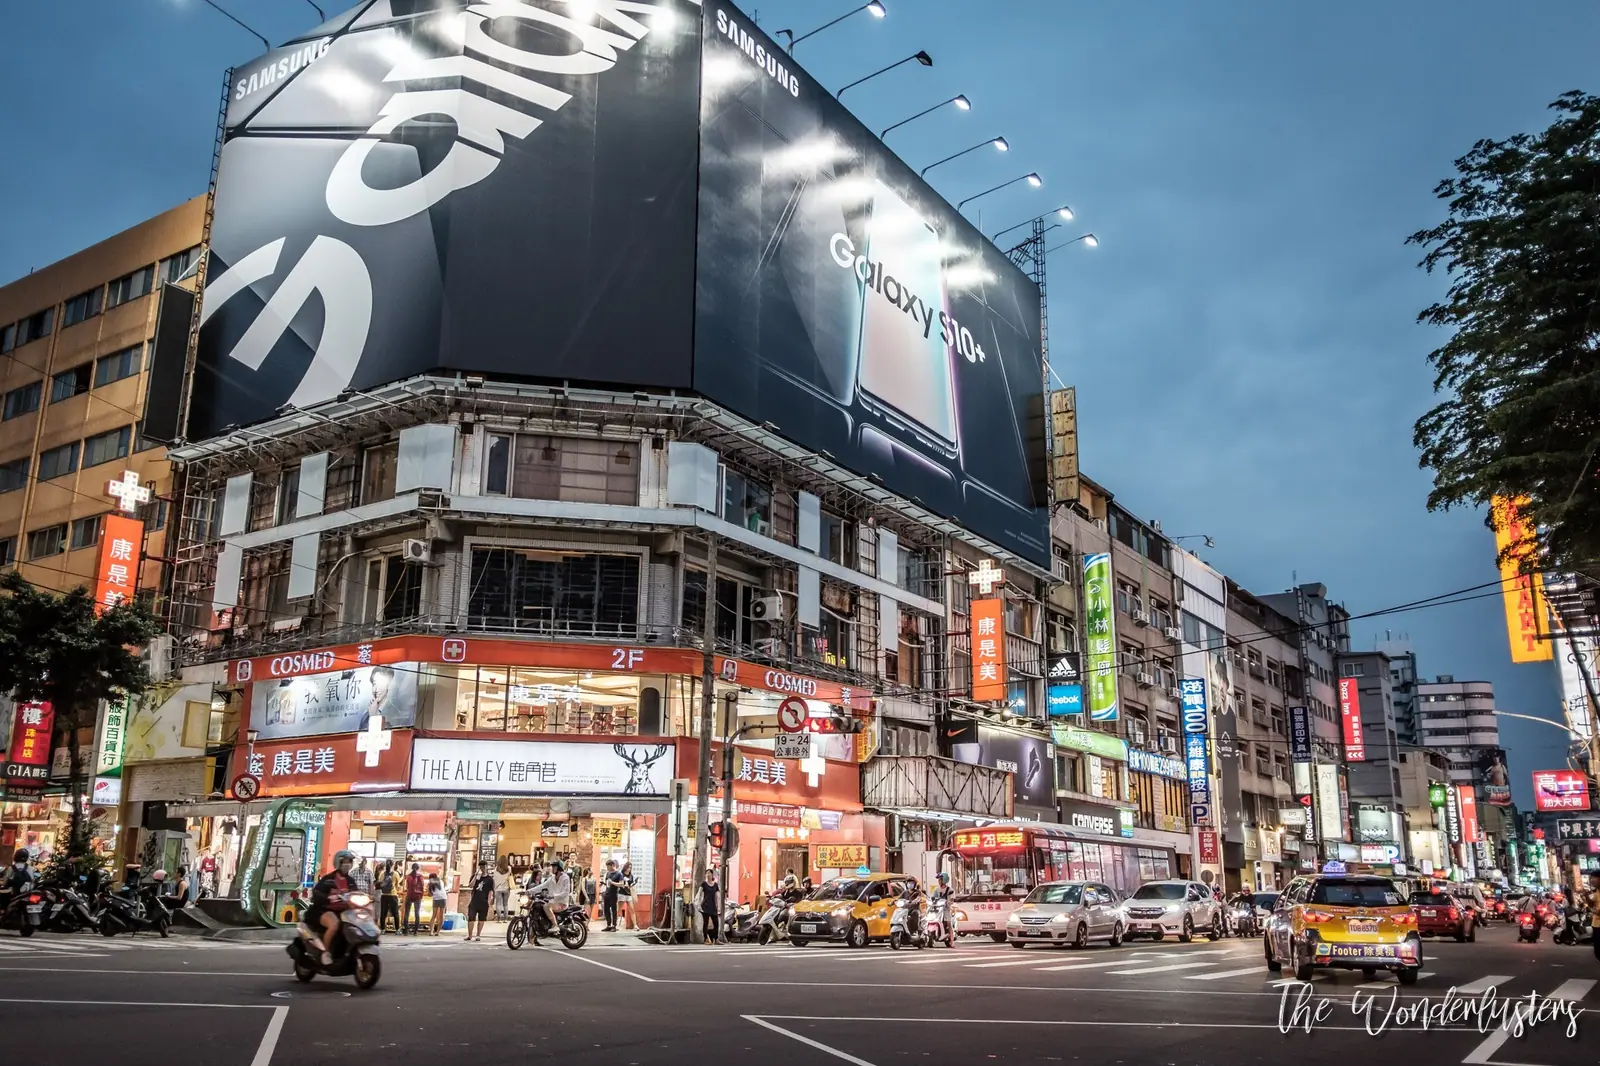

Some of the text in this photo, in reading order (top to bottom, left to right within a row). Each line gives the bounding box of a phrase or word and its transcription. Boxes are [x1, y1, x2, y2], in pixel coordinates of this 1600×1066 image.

[716, 8, 799, 98] SAMSUNG
[235, 36, 332, 101] SAMSUNG
[829, 231, 986, 363] Galaxy S10+
[611, 648, 644, 669] 2F
[977, 616, 998, 681] 康是美
[270, 650, 336, 677] COSMED
[1049, 669, 1077, 677] adidas
[764, 669, 817, 697] COSMED
[1049, 695, 1079, 704] Reebok
[271, 746, 336, 777] 康是美
[776, 746, 809, 757] 公車除外
[6, 764, 31, 777] GIA
[420, 758, 451, 780] THE
[454, 759, 505, 782] ALLEY
[508, 761, 557, 783] 鹿角巷
[1072, 813, 1114, 835] CONVERSE
[1447, 795, 1459, 842] CONVERSE
[600, 827, 622, 840] 栗子
[829, 847, 865, 862] 地瓜王
[1332, 945, 1362, 957] Footer
